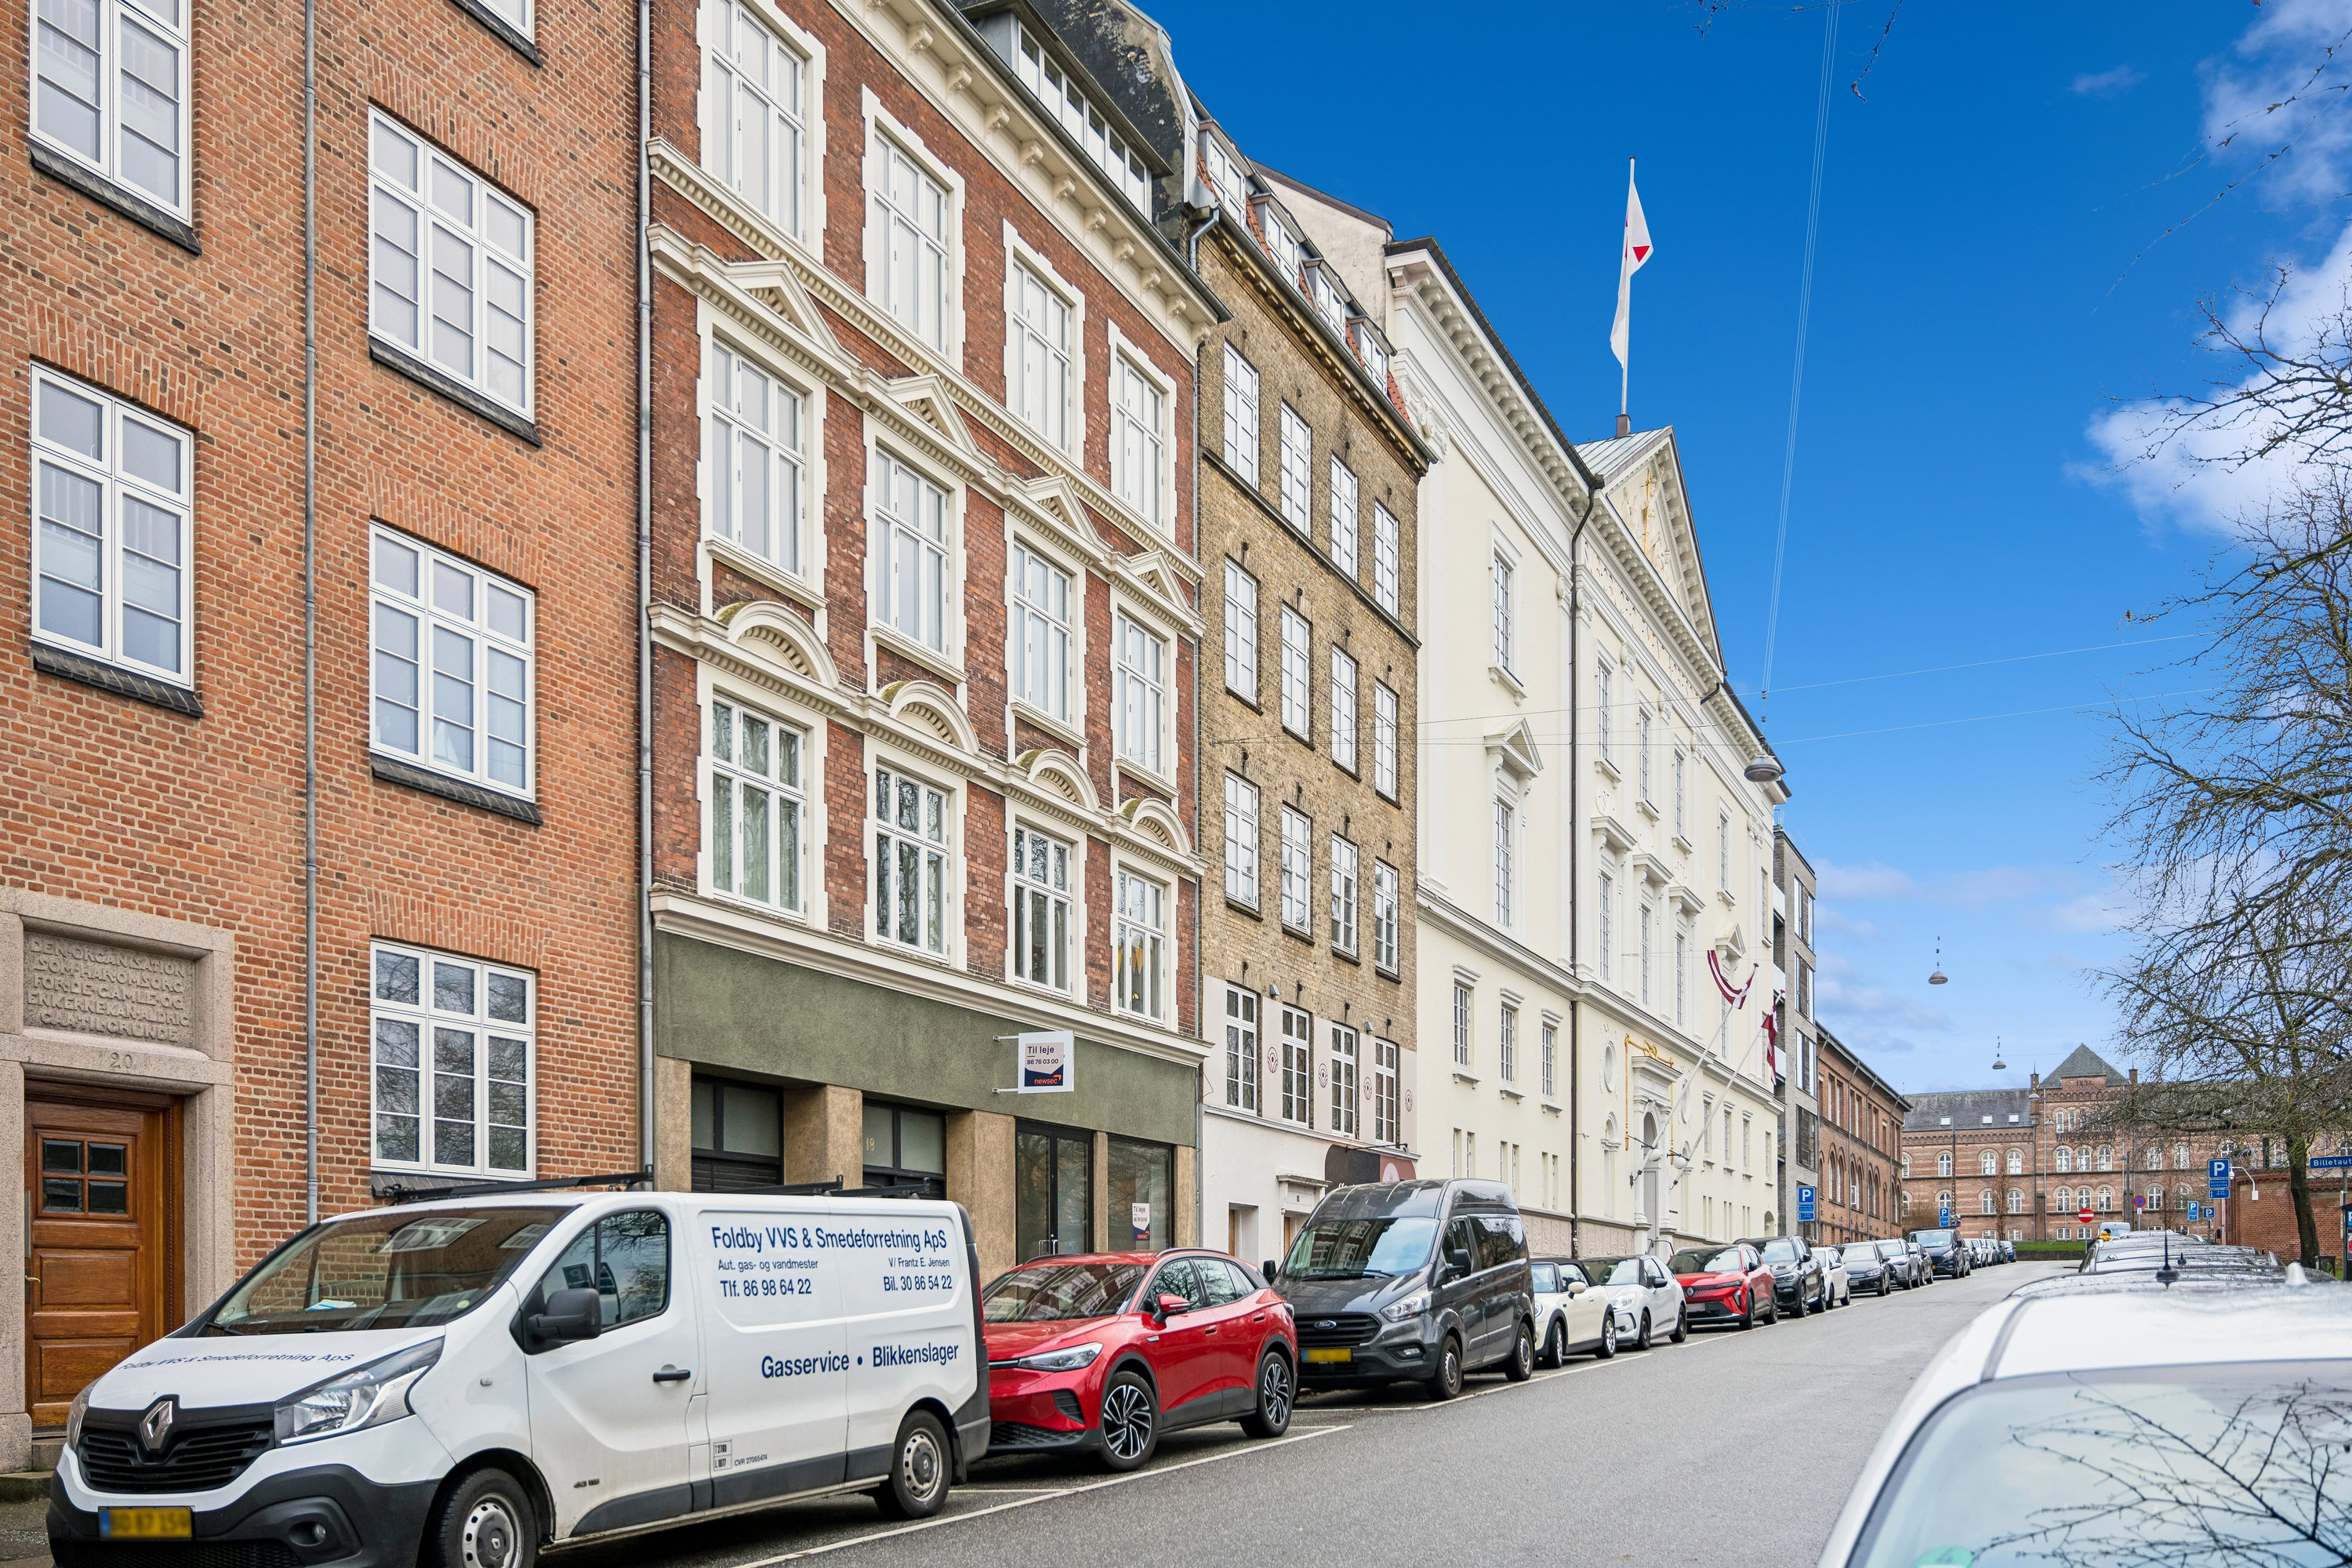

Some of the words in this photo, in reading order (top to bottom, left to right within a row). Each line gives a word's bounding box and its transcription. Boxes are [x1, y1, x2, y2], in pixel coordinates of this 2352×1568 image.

[1040, 1046, 1054, 1054] leje
[110, 1051, 133, 1069] 20
[2214, 1162, 2225, 1176] P
[1802, 1189, 1812, 1202] P
[712, 1227, 762, 1253] Foldby
[766, 1227, 797, 1248] VVS
[803, 1228, 813, 1248] &
[816, 1228, 920, 1253] Smedeforretning
[924, 1229, 946, 1252] ApS
[718, 1259, 735, 1270] Aut.
[739, 1261, 756, 1272] gas-
[760, 1261, 770, 1272] og
[772, 1259, 818, 1269] vandmester
[898, 1258, 919, 1267] Frantz
[920, 1258, 926, 1267] E.
[928, 1258, 949, 1267] Jensen
[720, 1280, 739, 1297] Tlf.
[743, 1280, 758, 1296] 86
[762, 1279, 776, 1296] 98
[780, 1279, 794, 1295] 64
[797, 1279, 811, 1294] 22
[884, 1276, 898, 1291] Bil.
[901, 1276, 912, 1290] 30
[915, 1276, 926, 1290] 86
[928, 1276, 939, 1290] 54
[942, 1275, 953, 1289] 22
[317, 1354, 355, 1363] ApS
[761, 1351, 849, 1378] Gasservice
[873, 1342, 958, 1367] Blikkenslager
[735, 1457, 746, 1467] CVR
